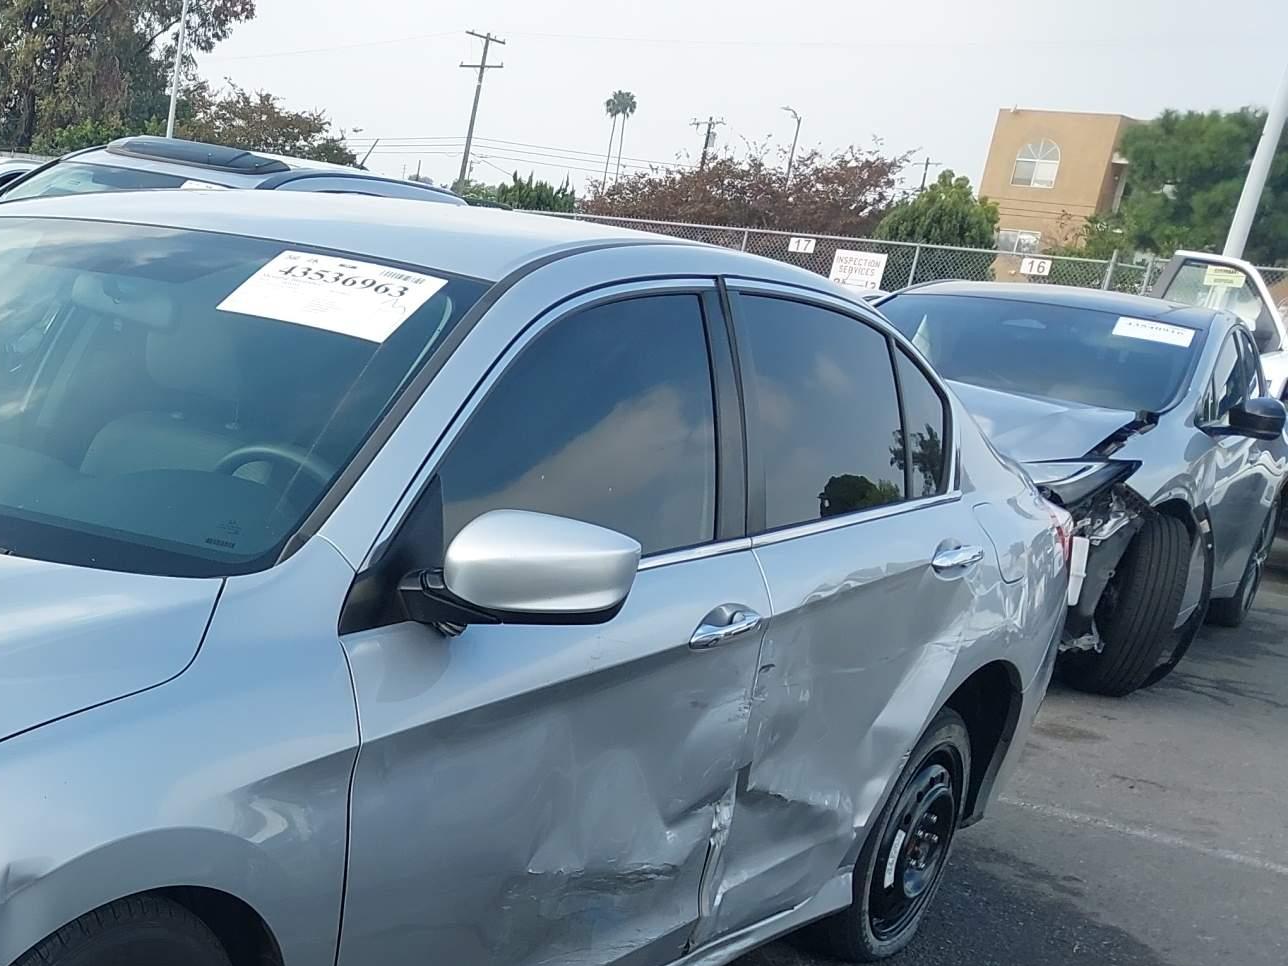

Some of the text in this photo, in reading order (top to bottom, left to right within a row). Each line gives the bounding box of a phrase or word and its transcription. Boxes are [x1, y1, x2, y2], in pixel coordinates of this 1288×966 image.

[795, 239, 812, 251] 17
[836, 256, 881, 268] INSPECTION
[1027, 260, 1046, 274] 16
[838, 265, 875, 276] SERVICES
[278, 264, 409, 298] 43536963
